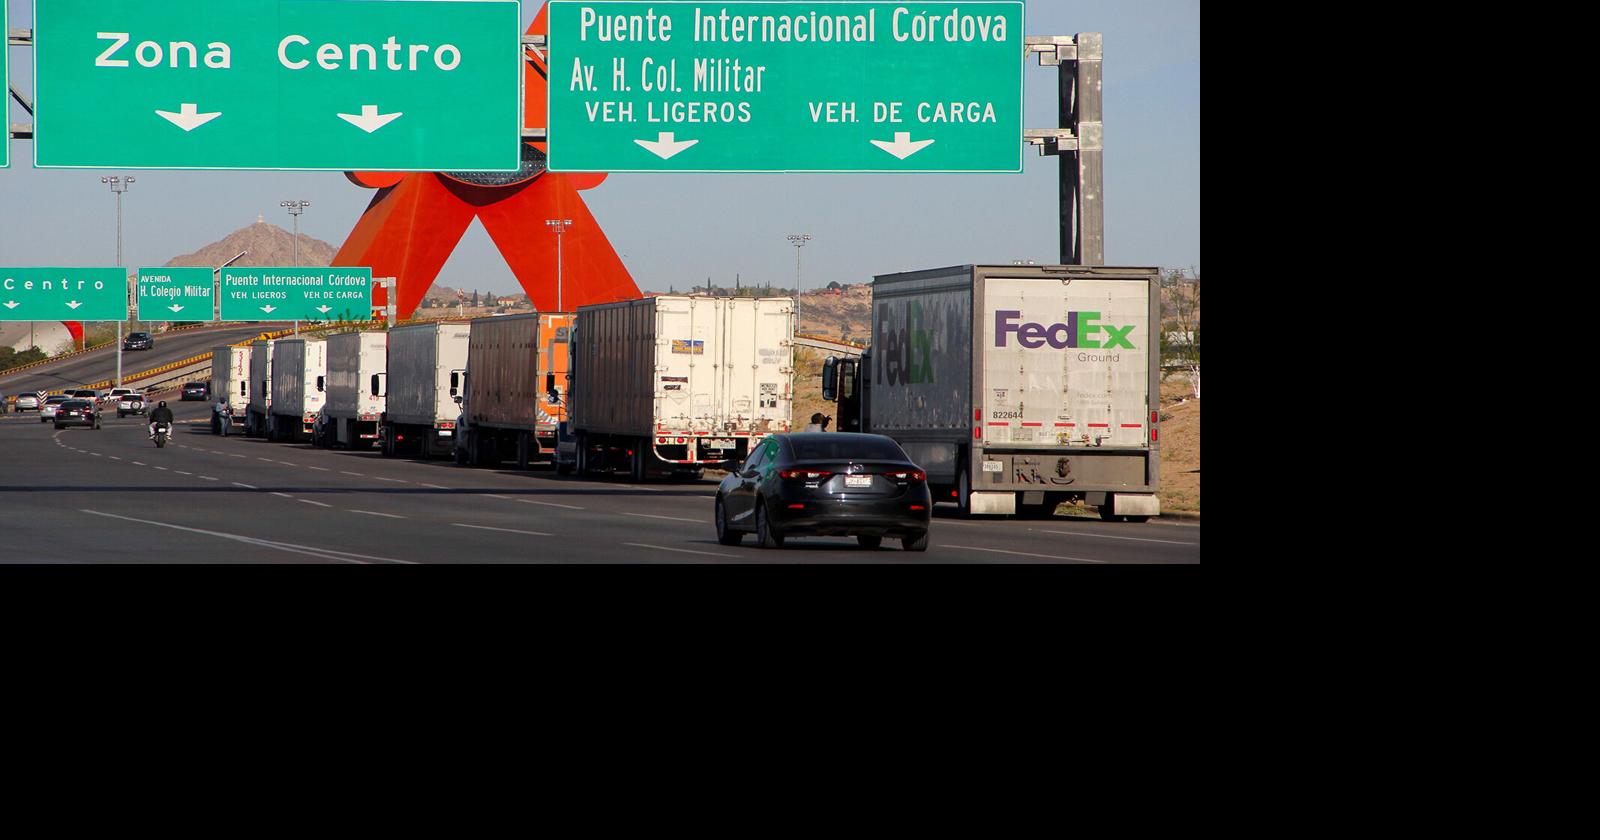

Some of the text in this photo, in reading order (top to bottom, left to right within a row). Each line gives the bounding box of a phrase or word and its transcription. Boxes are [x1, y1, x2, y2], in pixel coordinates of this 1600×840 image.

[581, 7, 1007, 42] Puente Internacional Córdova
[95, 32, 462, 71] Zona Centro
[570, 57, 766, 93] Av. H. Col. Militar
[585, 102, 752, 123] VEH. LIGEROS
[808, 102, 997, 123] VEH. DE CARGA
[3, 278, 104, 290] Centro
[140, 275, 172, 283] AVENIDA
[225, 274, 366, 286] Puente Internacional Córdova
[150, 285, 182, 301] Colegio
[184, 285, 211, 297] Militar
[252, 291, 287, 299] LIGEROS
[323, 291, 334, 299] DE
[336, 291, 363, 299] CARGA
[995, 310, 1137, 349] FedEx
[877, 300, 934, 386] FedEx
[1077, 352, 1120, 363] Ground
[993, 411, 1023, 419] 822644
